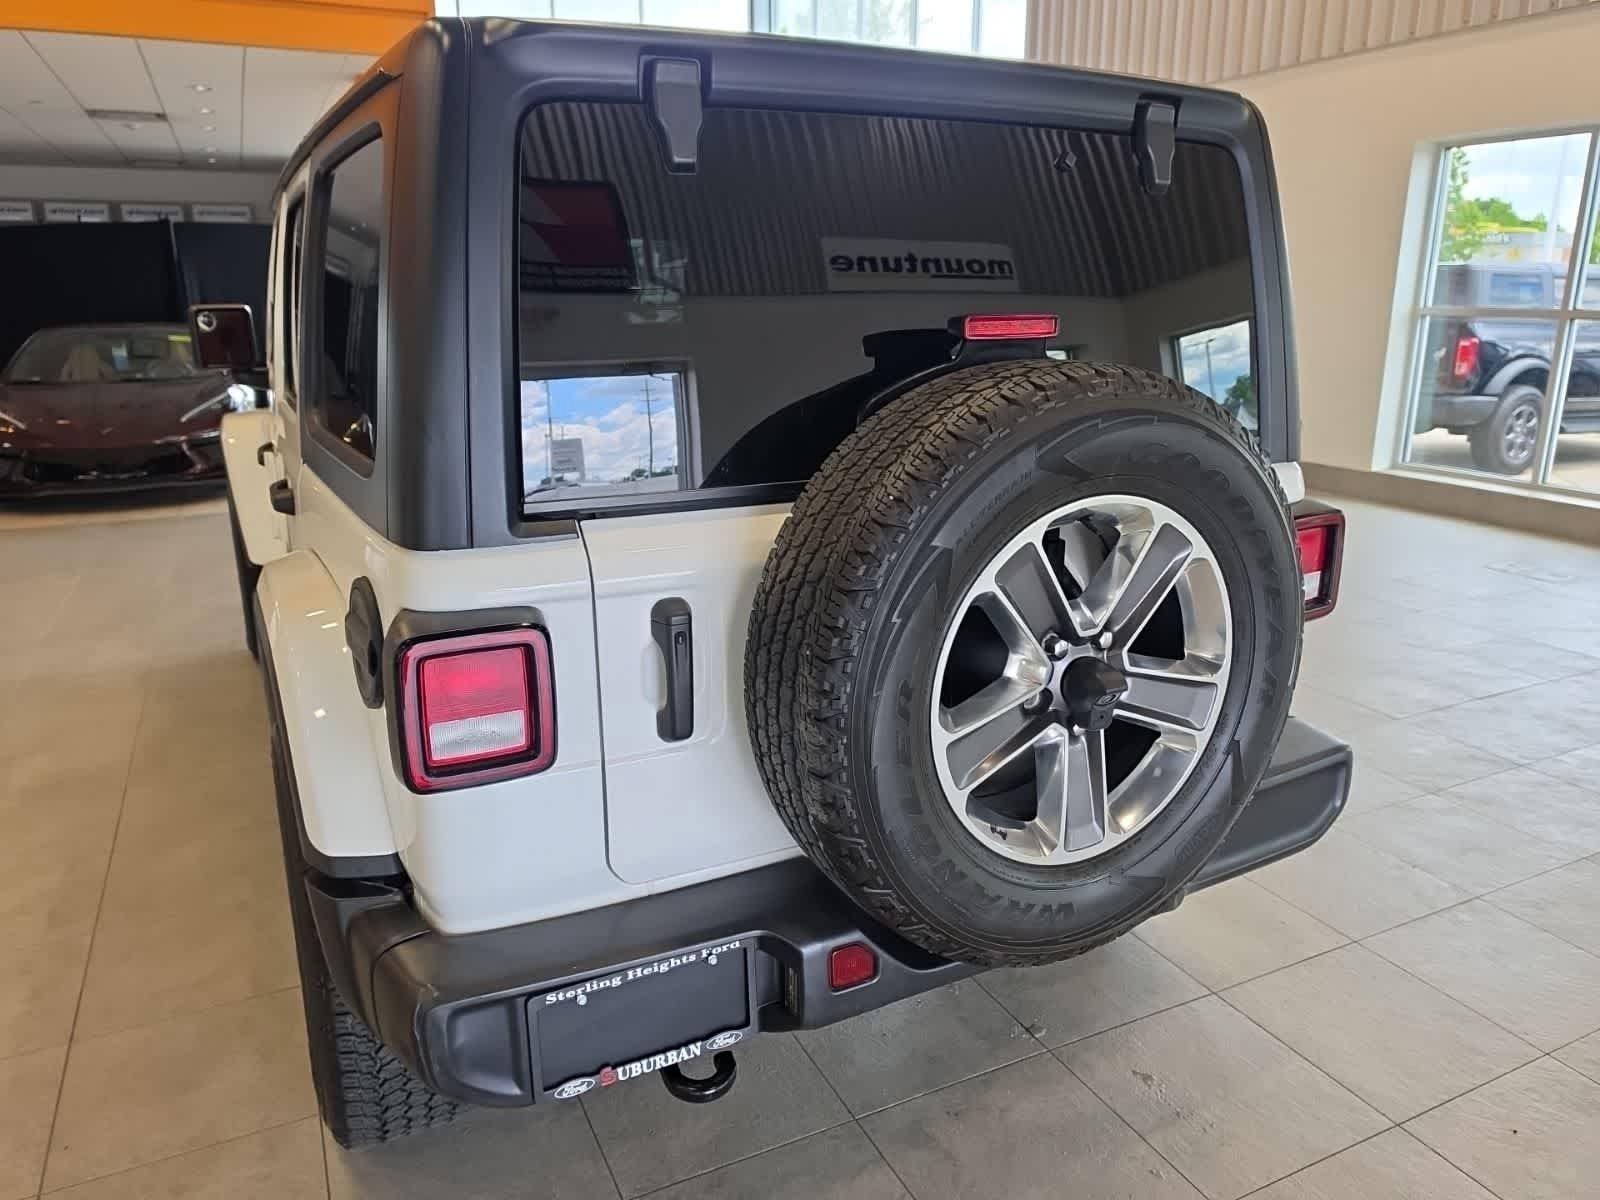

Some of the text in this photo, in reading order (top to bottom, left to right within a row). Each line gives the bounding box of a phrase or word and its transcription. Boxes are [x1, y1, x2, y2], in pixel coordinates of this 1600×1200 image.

[545, 941, 741, 1004] Sterling Heights Ford
[557, 1032, 740, 1098] Ford SUBURBAN Ford
